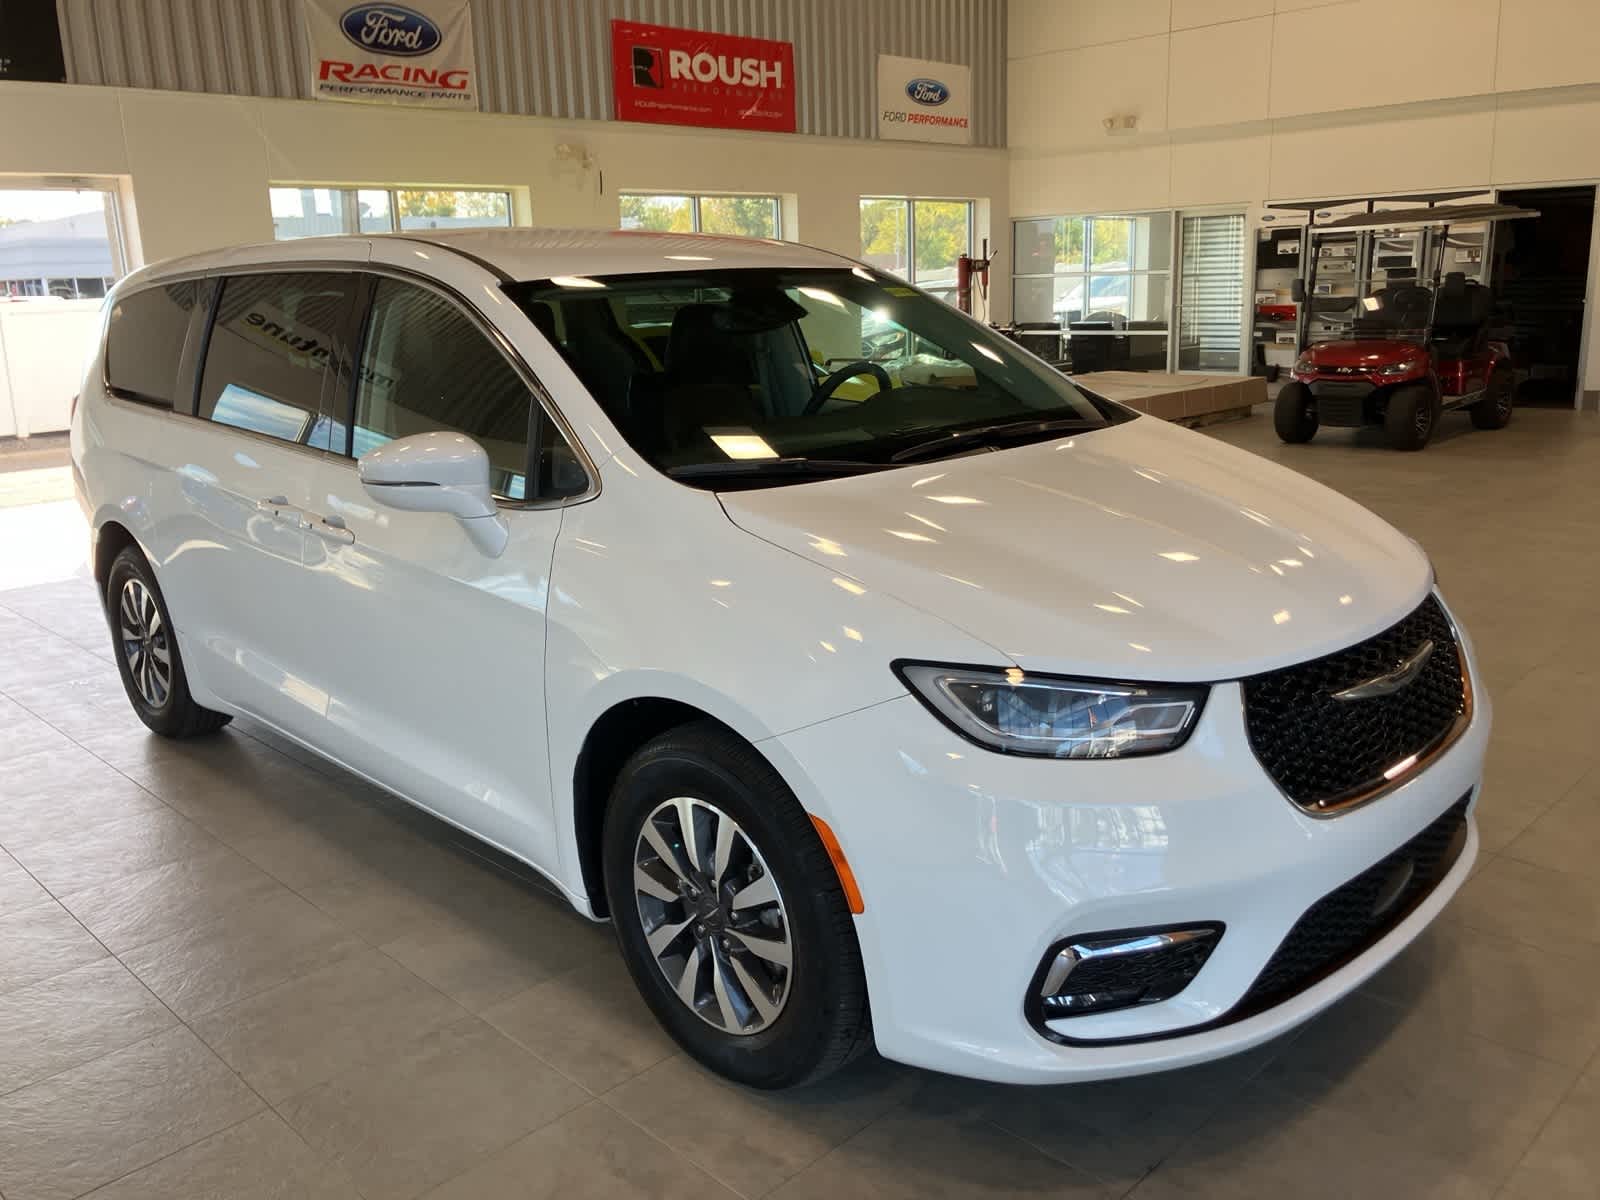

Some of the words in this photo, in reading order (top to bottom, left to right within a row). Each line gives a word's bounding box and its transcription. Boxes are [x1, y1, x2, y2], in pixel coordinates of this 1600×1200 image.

[361, 10, 422, 49] Ford
[319, 60, 469, 90] RACING
[669, 49, 783, 89] ROUSH
[319, 83, 426, 98] PERFORMANCE
[431, 93, 471, 101] PARTS
[914, 82, 942, 102] Ford
[883, 111, 907, 123] FORD
[907, 113, 969, 129] PERFORMANCE
